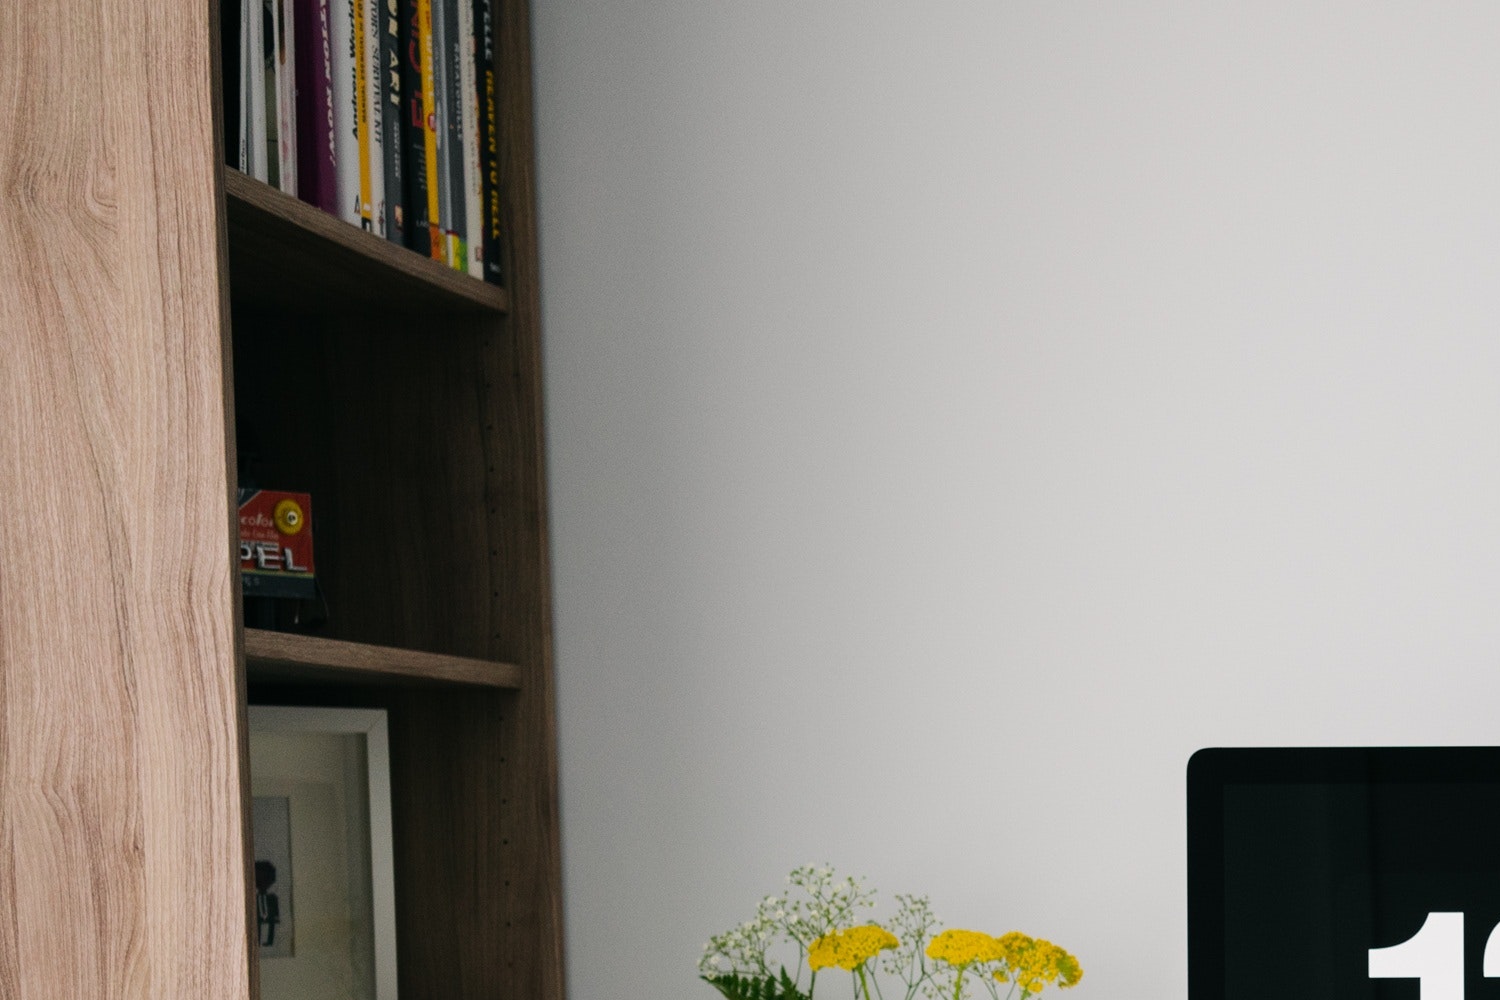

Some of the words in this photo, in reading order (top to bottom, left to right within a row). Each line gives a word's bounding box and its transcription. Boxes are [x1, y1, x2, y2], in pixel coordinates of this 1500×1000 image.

[372, 44, 382, 115] SURVIVAL
[389, 48, 402, 107] ART
[486, 69, 499, 153] HEAVEN
[325, 85, 337, 167] NOW!
